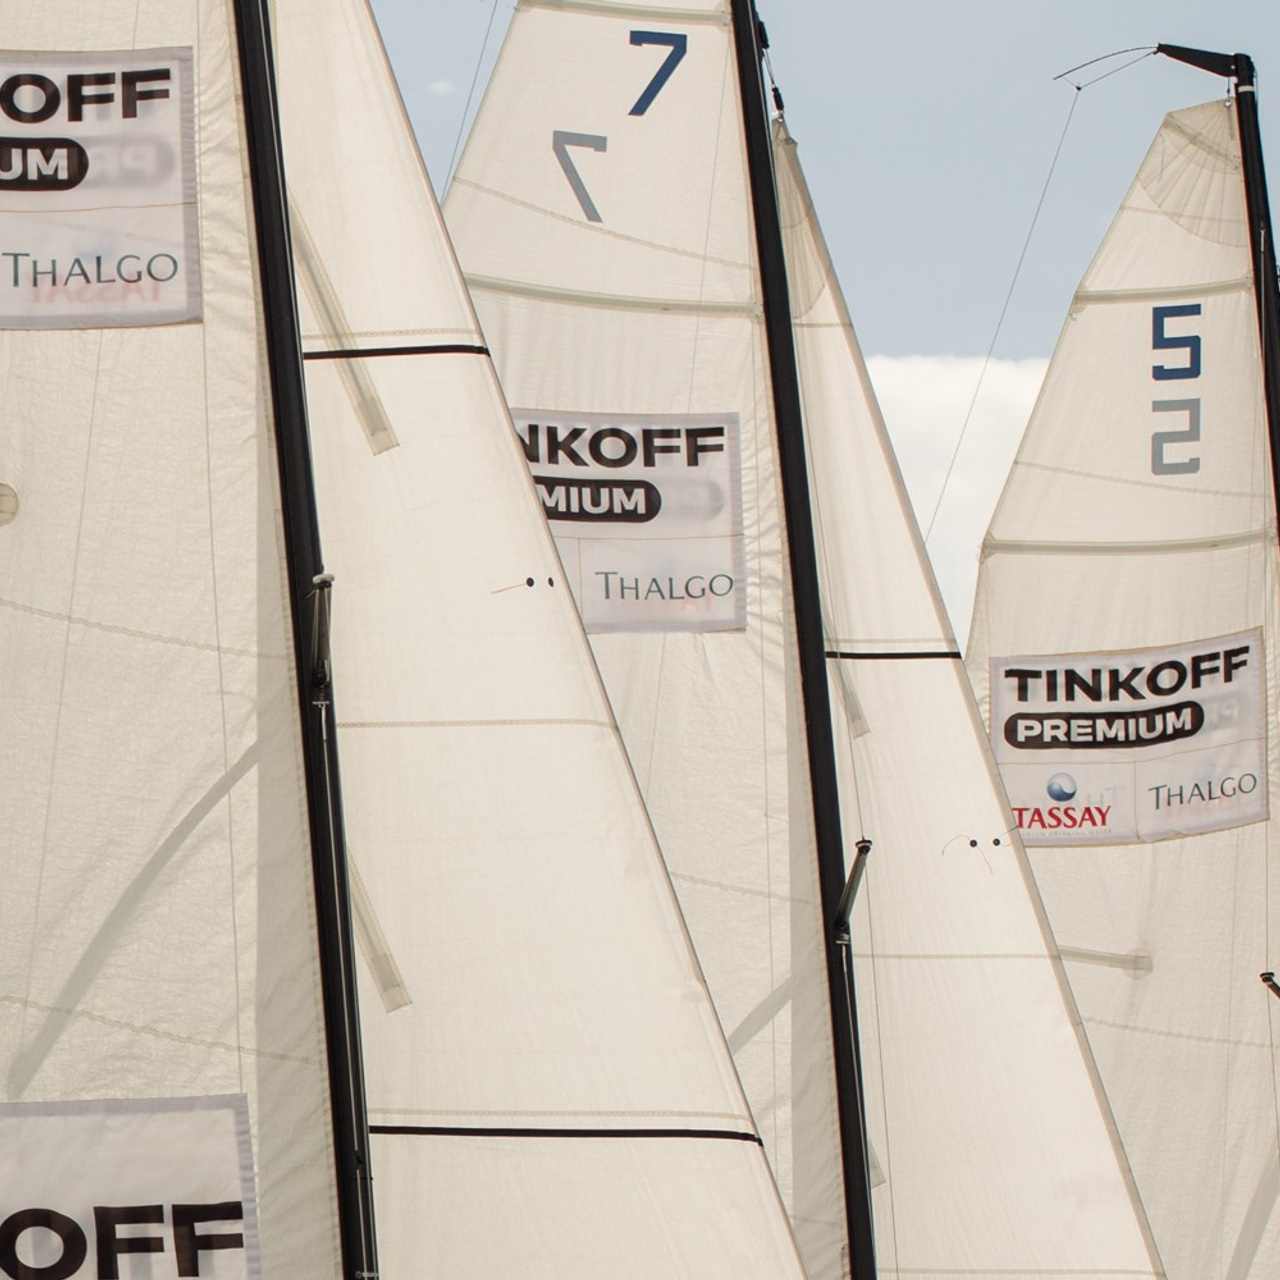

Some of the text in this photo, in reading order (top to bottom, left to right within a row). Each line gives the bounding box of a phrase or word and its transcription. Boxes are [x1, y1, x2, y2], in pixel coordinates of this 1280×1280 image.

[628, 30, 687, 116] 7
[2, 251, 178, 287] THALGO
[1152, 303, 1201, 381] 5
[517, 424, 724, 468] NKOFF
[536, 483, 646, 515] MIUM
[595, 572, 734, 601] THALGO
[1004, 645, 1250, 702] TINKOFF
[1016, 707, 1192, 743] PREMIUM
[1148, 773, 1257, 810] THALGO
[1011, 805, 1112, 829] TASSAY
